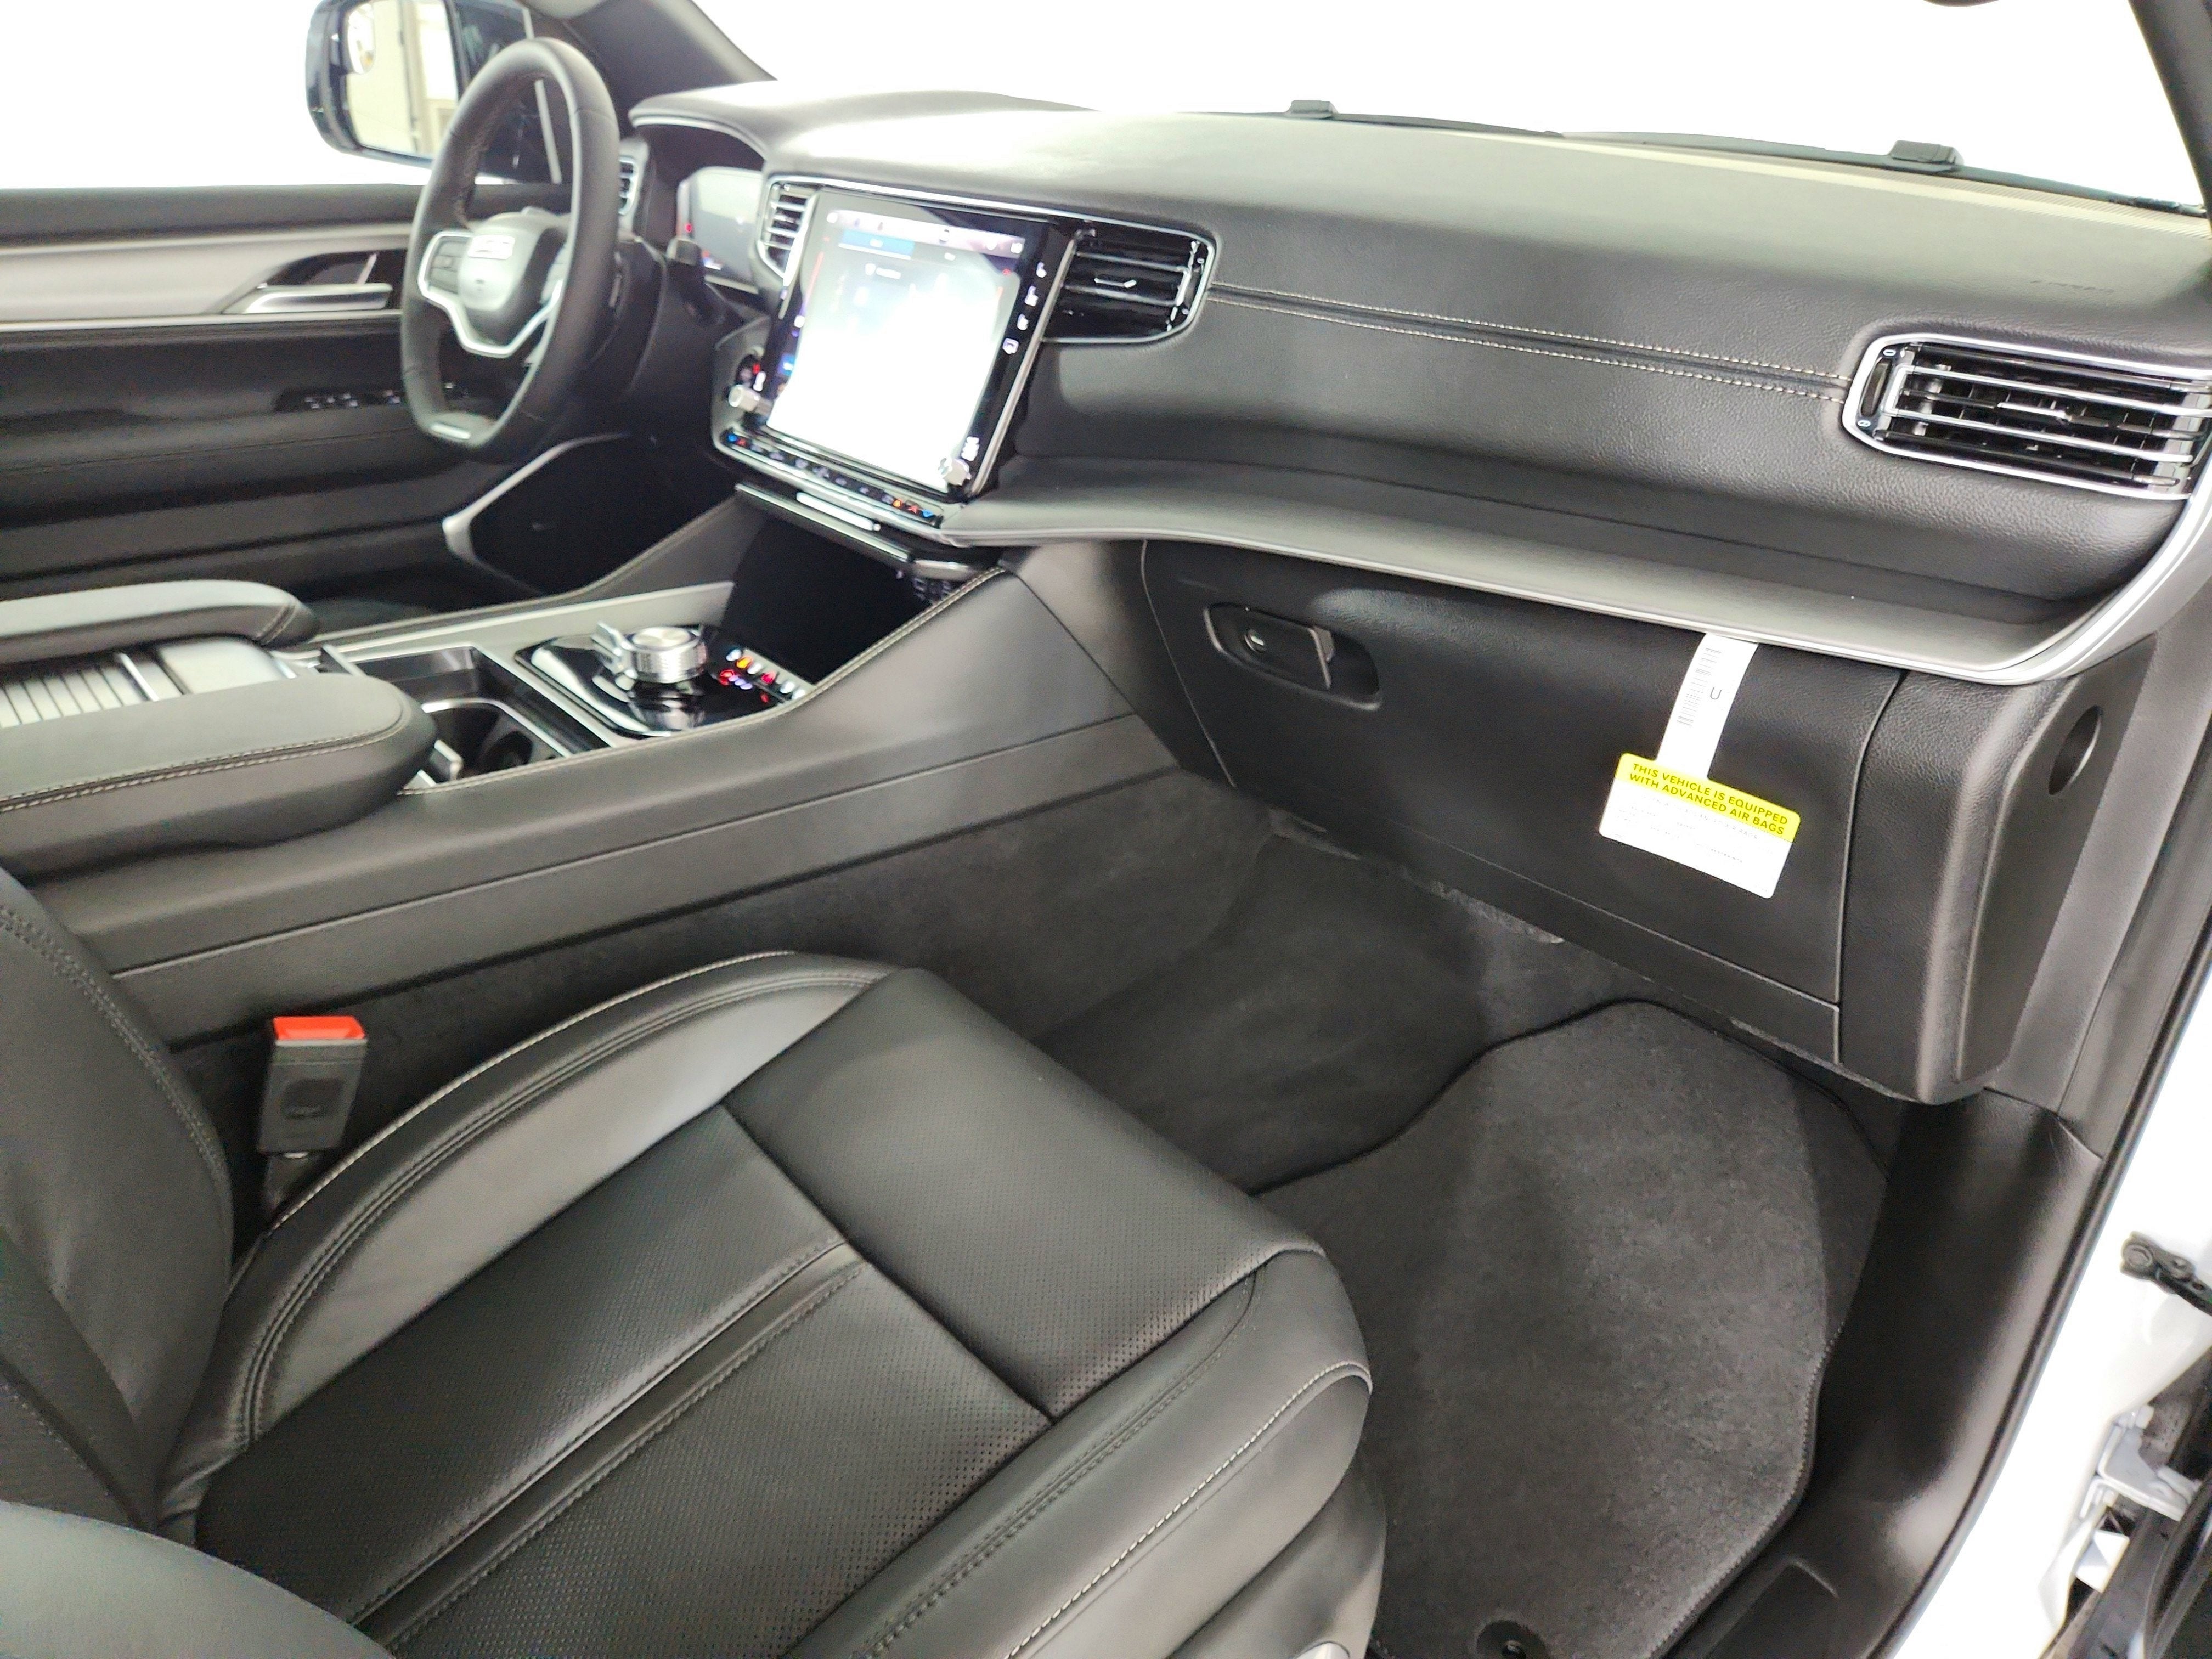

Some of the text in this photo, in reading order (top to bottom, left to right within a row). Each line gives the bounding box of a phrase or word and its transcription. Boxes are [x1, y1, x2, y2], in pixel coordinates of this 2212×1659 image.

[1710, 687, 1722, 700] U
[1630, 773, 1660, 788] WITH
[1662, 785, 1726, 811] ADVANCED
[1729, 809, 1750, 821] AIR
[1753, 816, 1785, 835] BAGS
[1633, 763, 1658, 777] THIS
[1663, 772, 1712, 795] VEHICLE
[1714, 791, 1725, 800] IS
[1728, 796, 1788, 825] EQUIPPED
